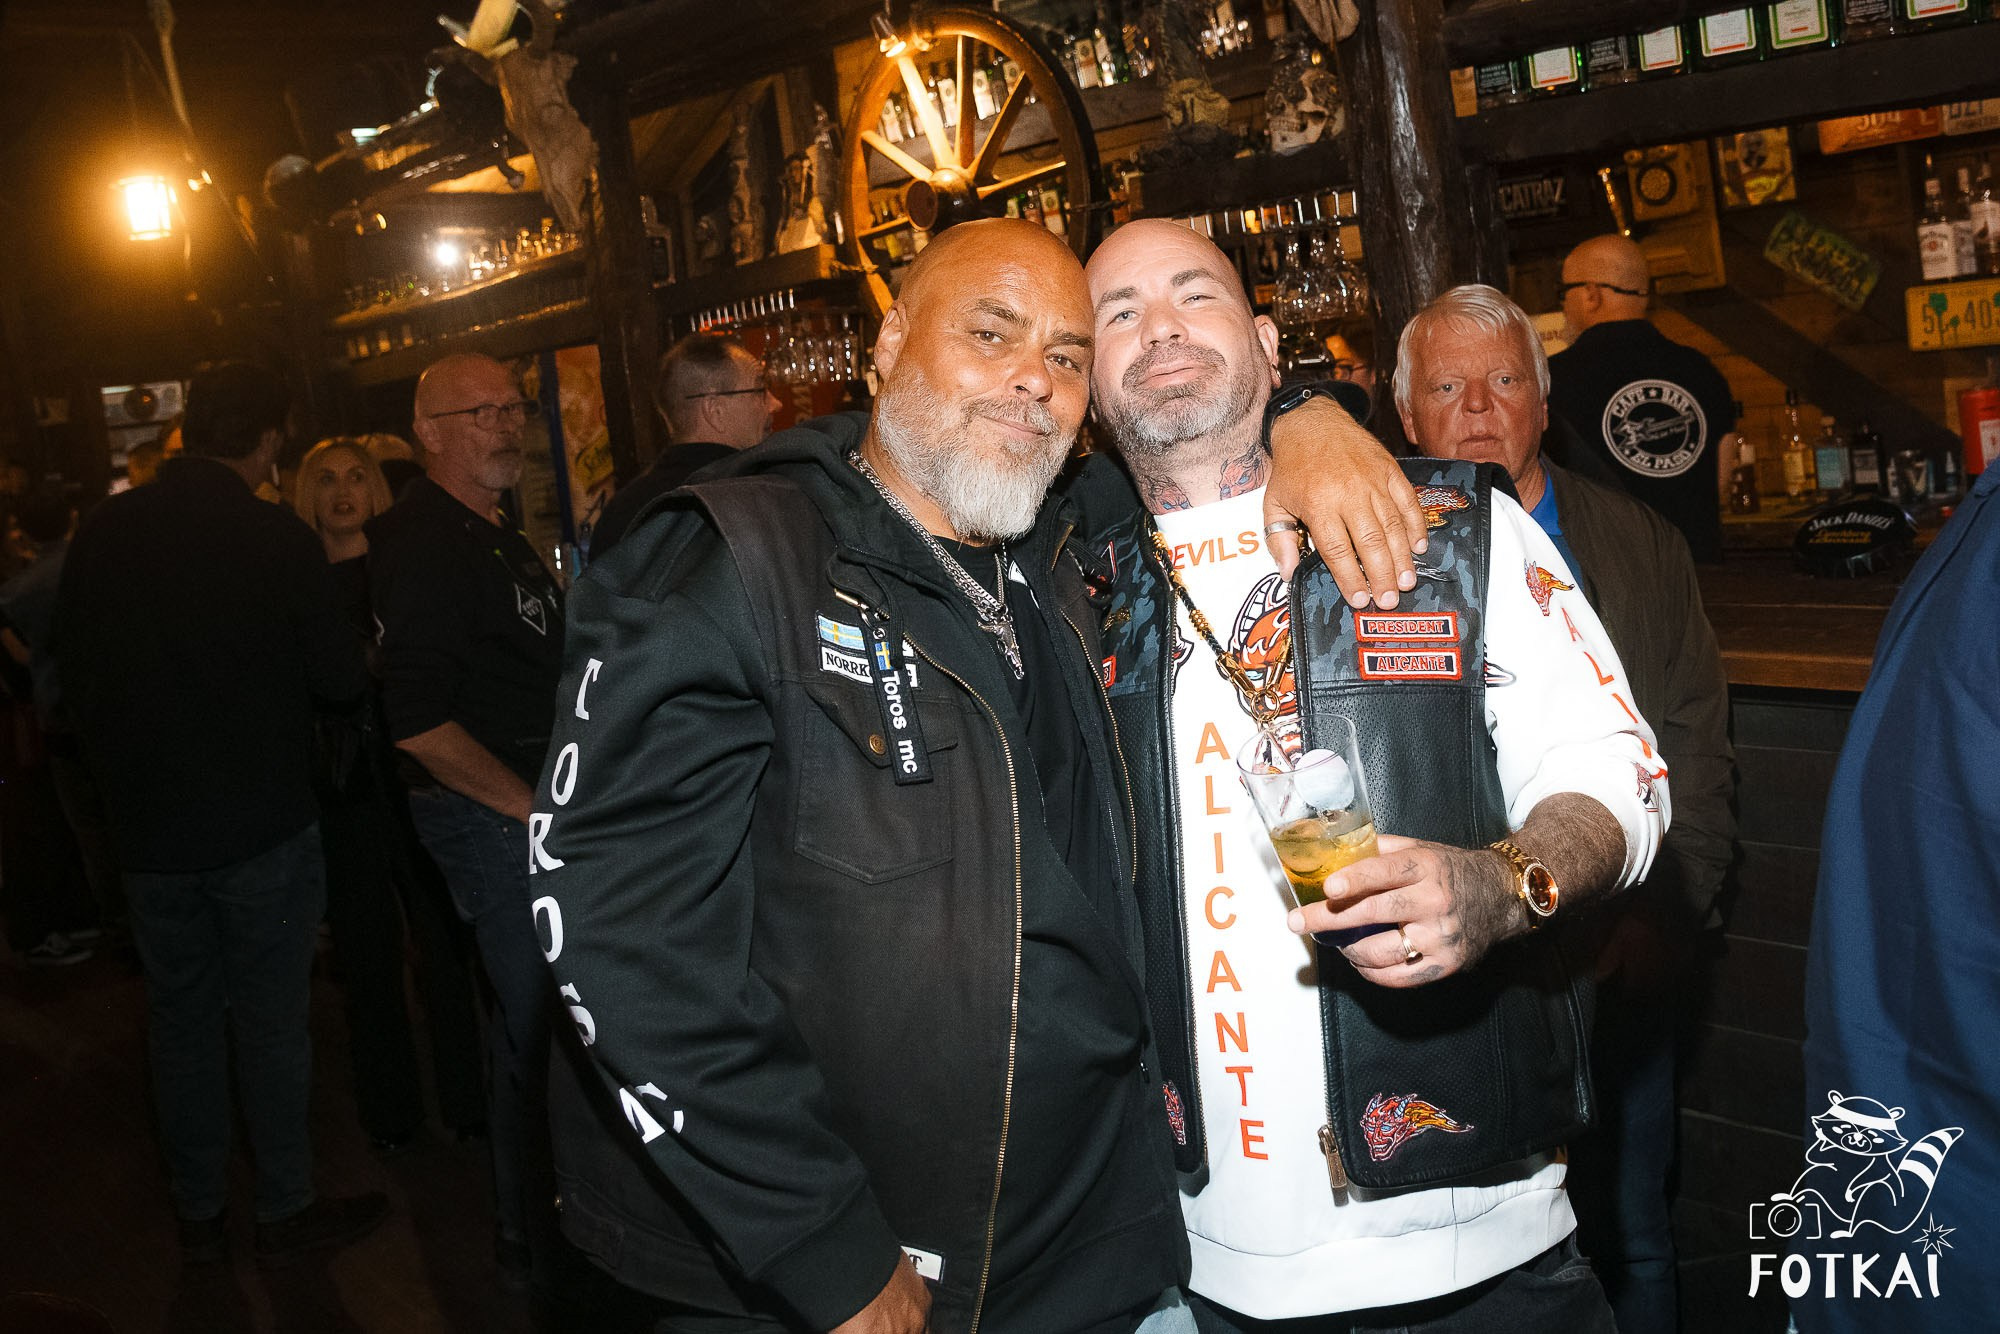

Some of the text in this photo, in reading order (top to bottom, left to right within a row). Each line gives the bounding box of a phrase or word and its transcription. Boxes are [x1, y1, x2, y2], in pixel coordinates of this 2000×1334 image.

[1661, 387, 1690, 414] BAR
[1630, 450, 1692, 469] EL PASO
[1808, 515, 1843, 531] JACK
[1367, 620, 1444, 634] PRESIDENT
[825, 651, 870, 678] NORRK
[1376, 655, 1447, 671] ALICANTE
[881, 669, 919, 775] Toros mc
[1195, 721, 1269, 1161] ALICANTE
